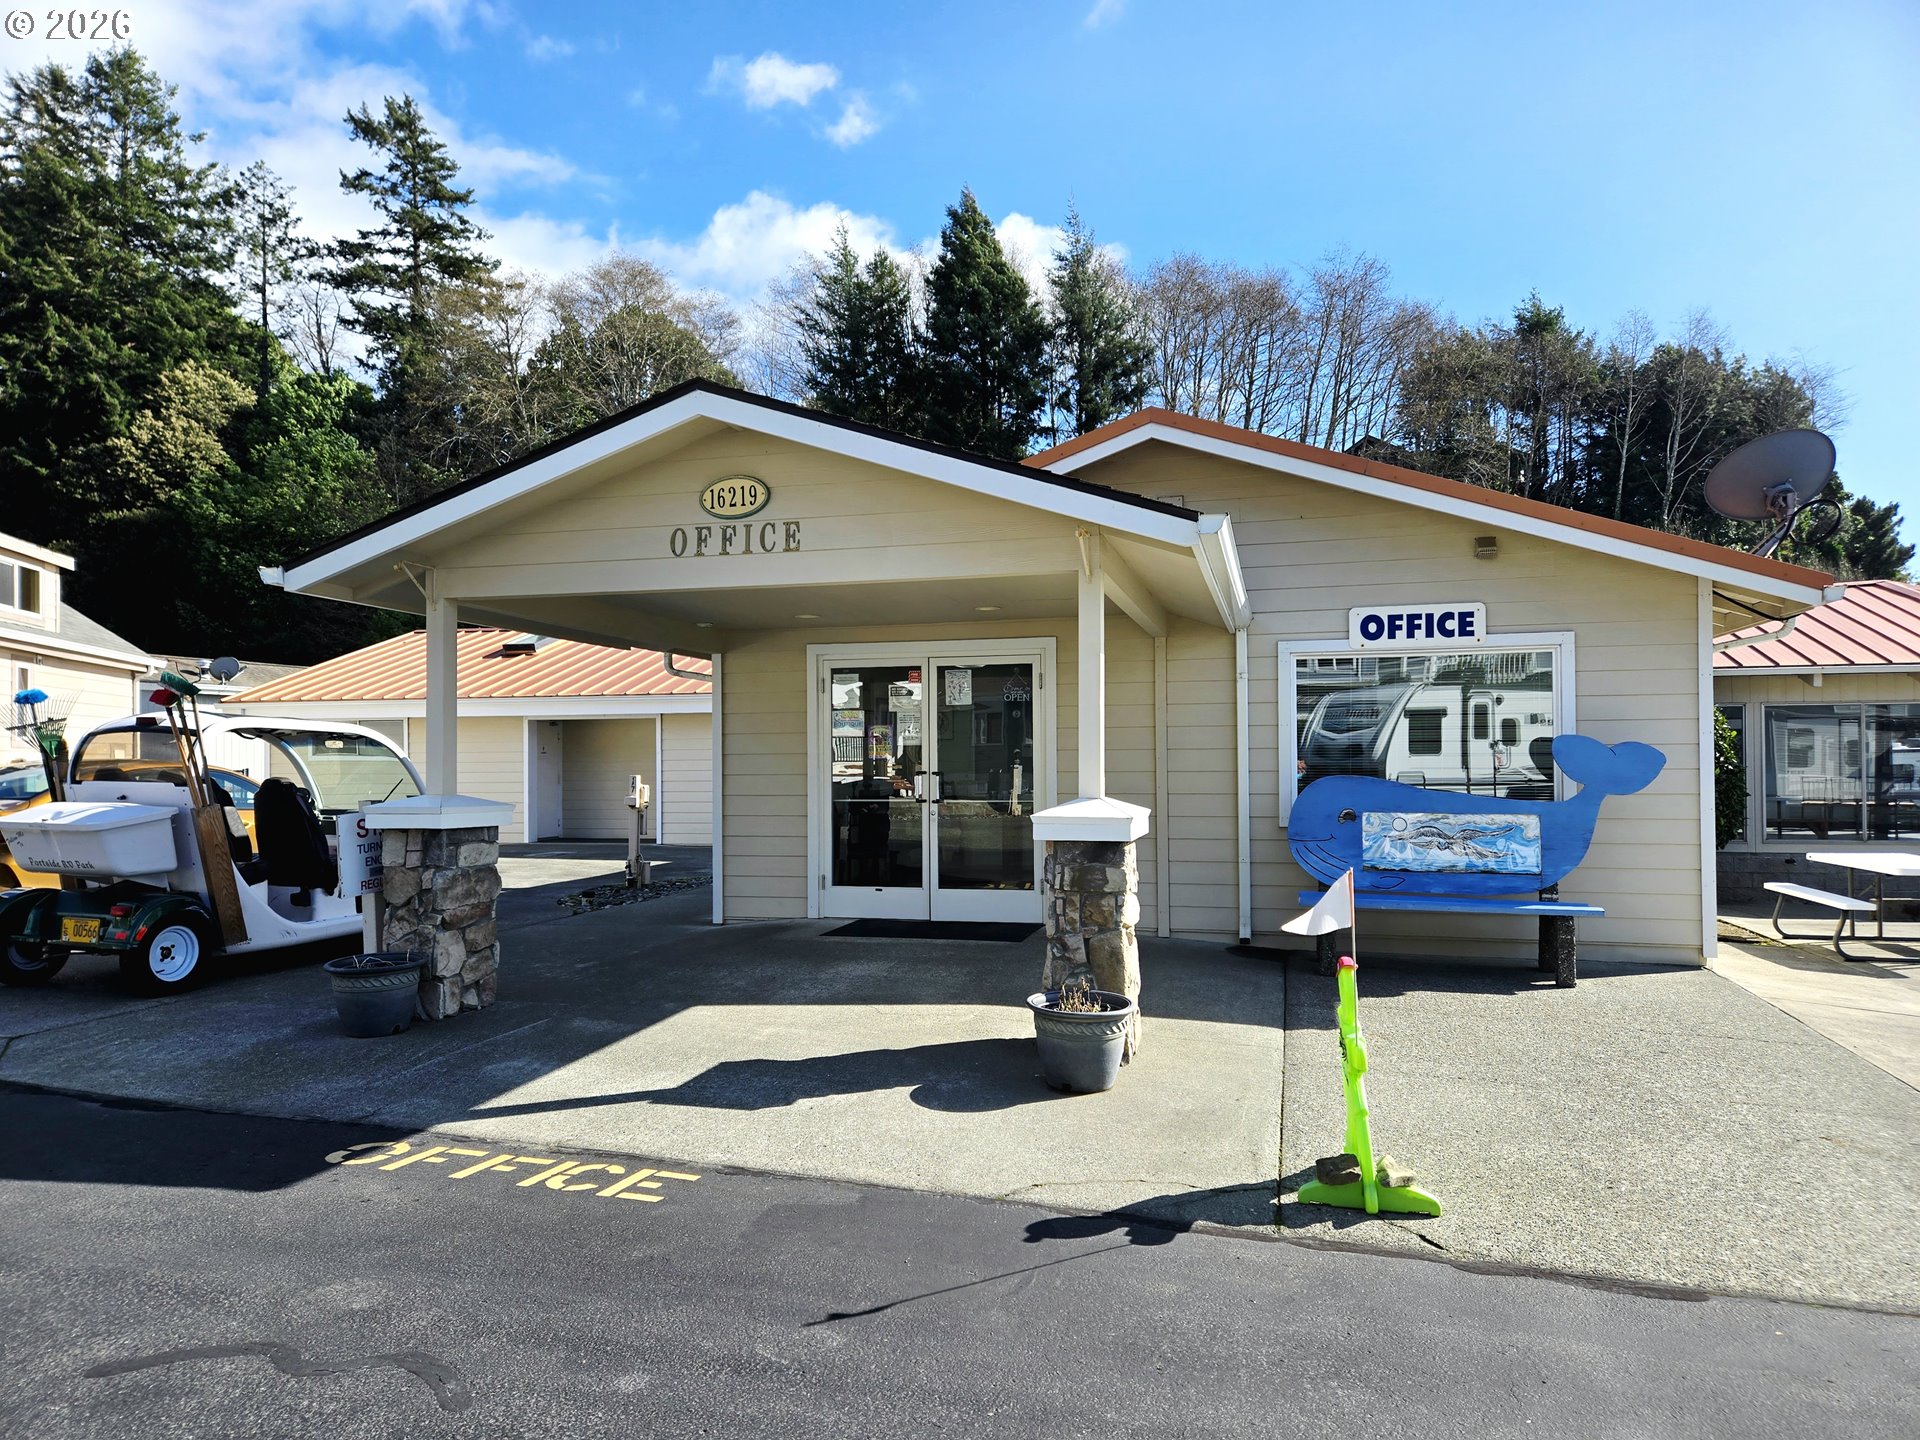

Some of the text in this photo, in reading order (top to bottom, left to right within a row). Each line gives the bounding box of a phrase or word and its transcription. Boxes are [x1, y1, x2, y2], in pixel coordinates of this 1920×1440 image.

[709, 485, 757, 509] 16219
[670, 521, 801, 557] OFFICE
[1359, 610, 1476, 641] OFFICE
[1003, 693, 1030, 702] OPEN
[357, 842, 383, 855] TURN
[29, 857, 95, 870] Portside RV Park
[360, 877, 383, 891] REGI
[73, 925, 97, 938] 00566
[324, 1141, 702, 1204] OFFICE
